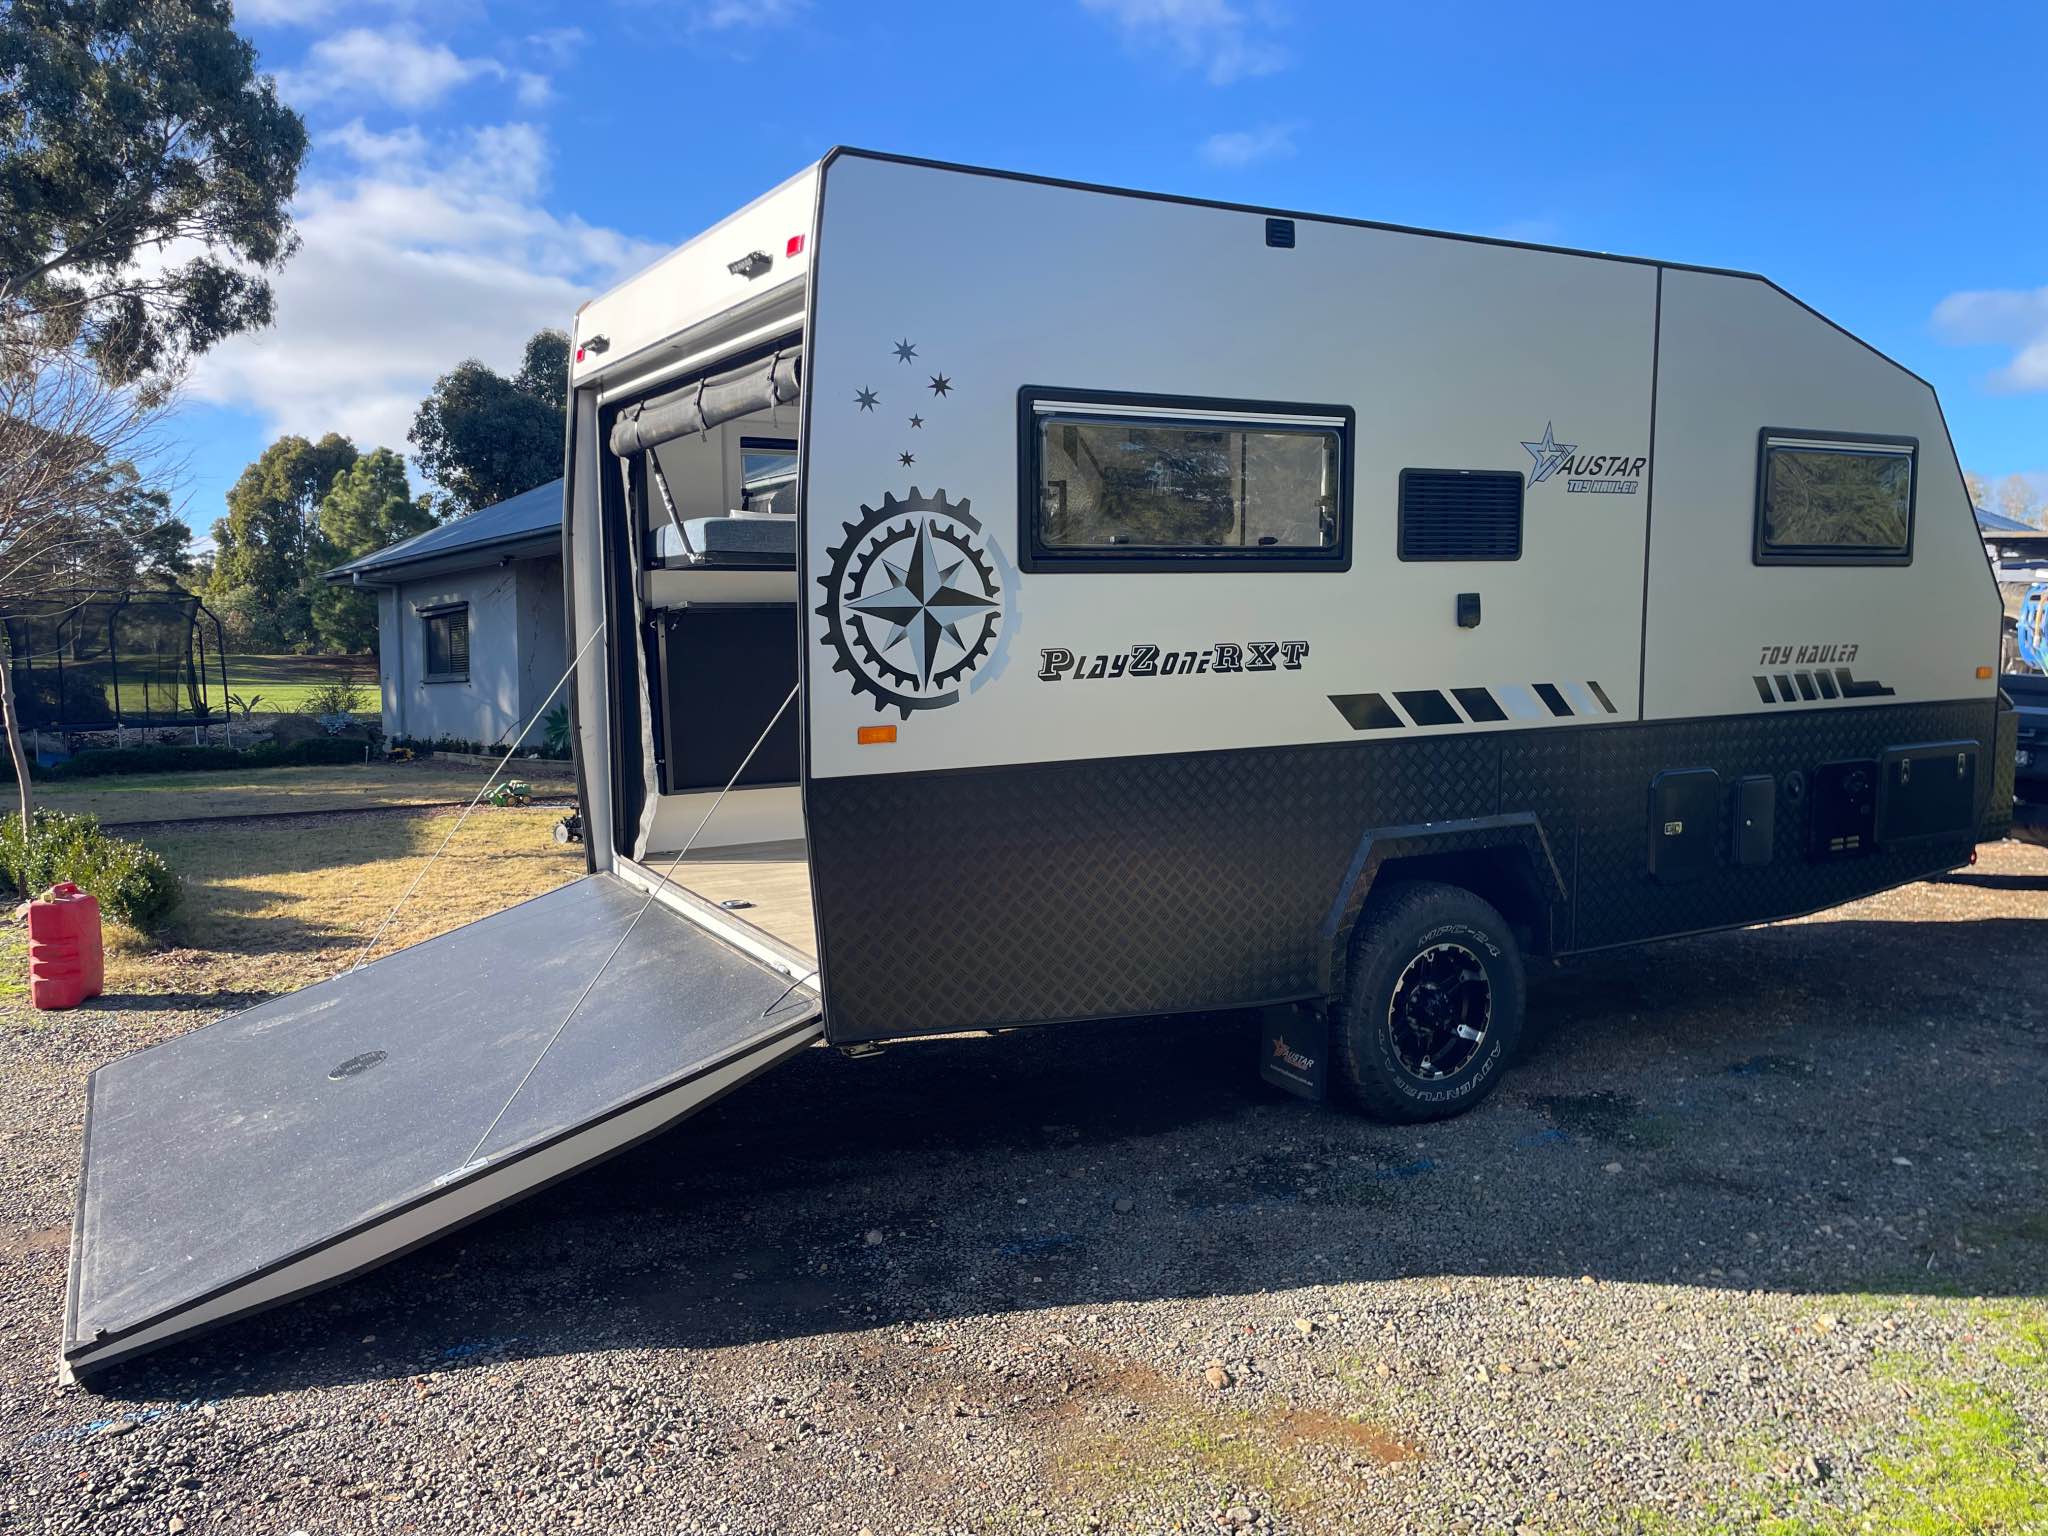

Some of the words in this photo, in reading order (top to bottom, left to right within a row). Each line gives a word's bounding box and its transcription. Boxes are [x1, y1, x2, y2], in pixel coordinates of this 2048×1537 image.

[1556, 455, 1647, 477] AUSTAR
[1760, 645, 1793, 666] TOY
[1795, 643, 1859, 665] HAULER
